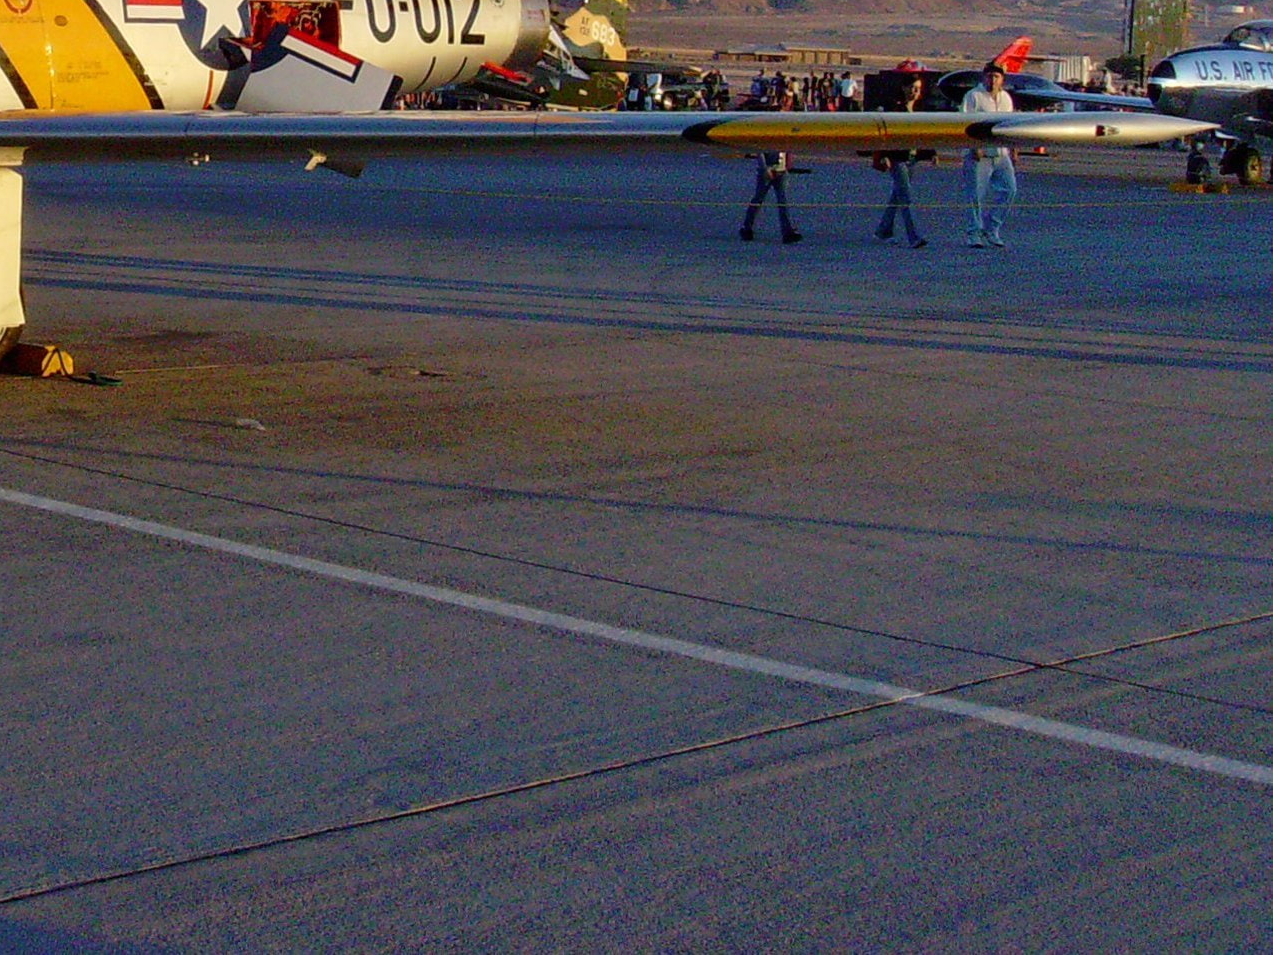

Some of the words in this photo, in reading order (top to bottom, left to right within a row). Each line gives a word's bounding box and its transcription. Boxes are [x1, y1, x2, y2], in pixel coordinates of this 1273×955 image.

[591, 20, 616, 46] 683
[1193, 60, 1227, 81] U.S.
[1231, 60, 1256, 81] AIR
